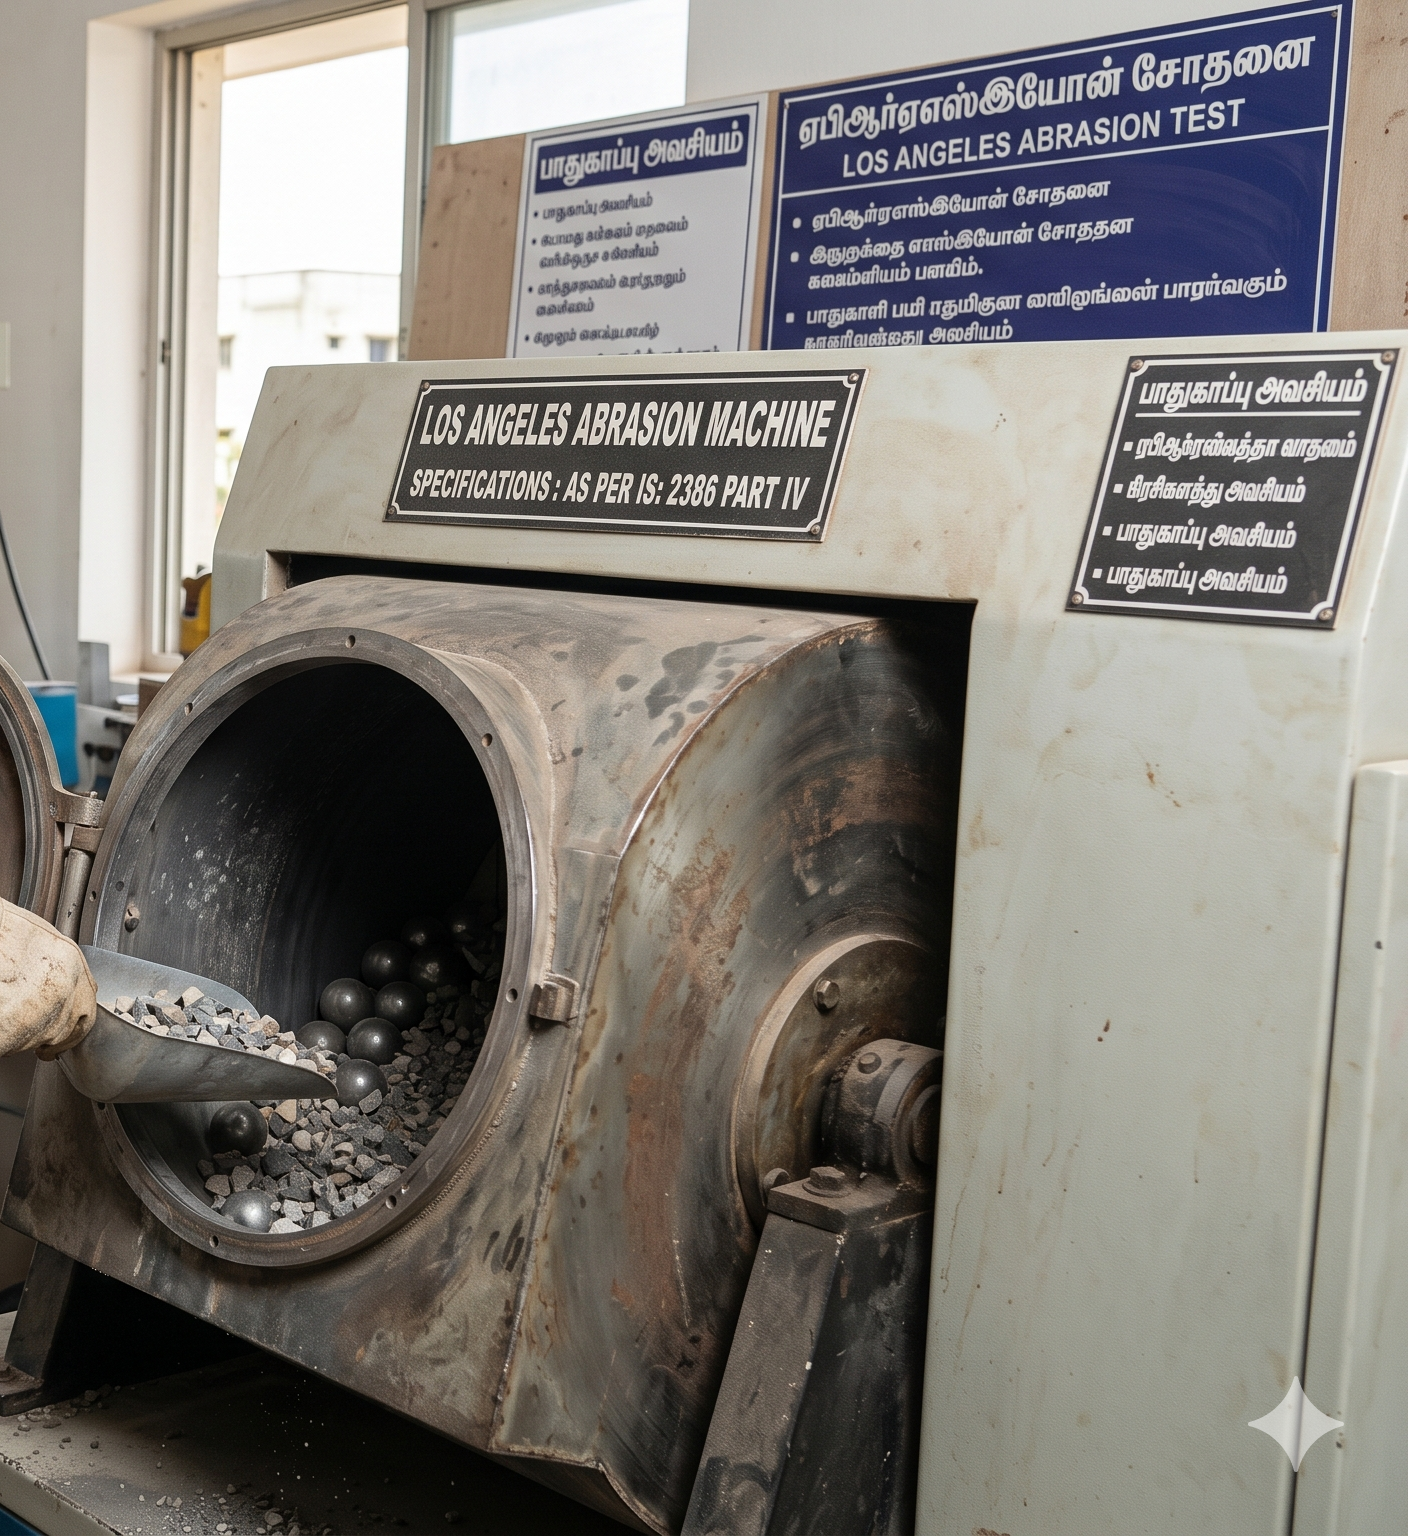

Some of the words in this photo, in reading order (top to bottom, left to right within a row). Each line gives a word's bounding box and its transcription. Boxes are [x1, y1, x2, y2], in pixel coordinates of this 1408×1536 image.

[1132, 36, 1316, 94] சோதனை
[843, 149, 889, 177] LOS
[894, 132, 1011, 171] ANGELES
[1017, 110, 1161, 155] ABRASION
[1170, 98, 1246, 134] TEST
[1139, 371, 1253, 414] பாதுகாப்பு
[1255, 368, 1368, 406] அவசியம்
[419, 404, 466, 446] LOS
[463, 402, 572, 446] ANGELES
[571, 401, 708, 447] ABRASION
[703, 400, 837, 448] MACHINE
[409, 469, 554, 501] SPECIFICATIONS
[562, 472, 592, 503] AS
[593, 472, 635, 505] PER
[635, 473, 664, 505] IS:
[664, 474, 717, 507] 2386
[720, 474, 781, 509] PART
[781, 476, 811, 510] IV
